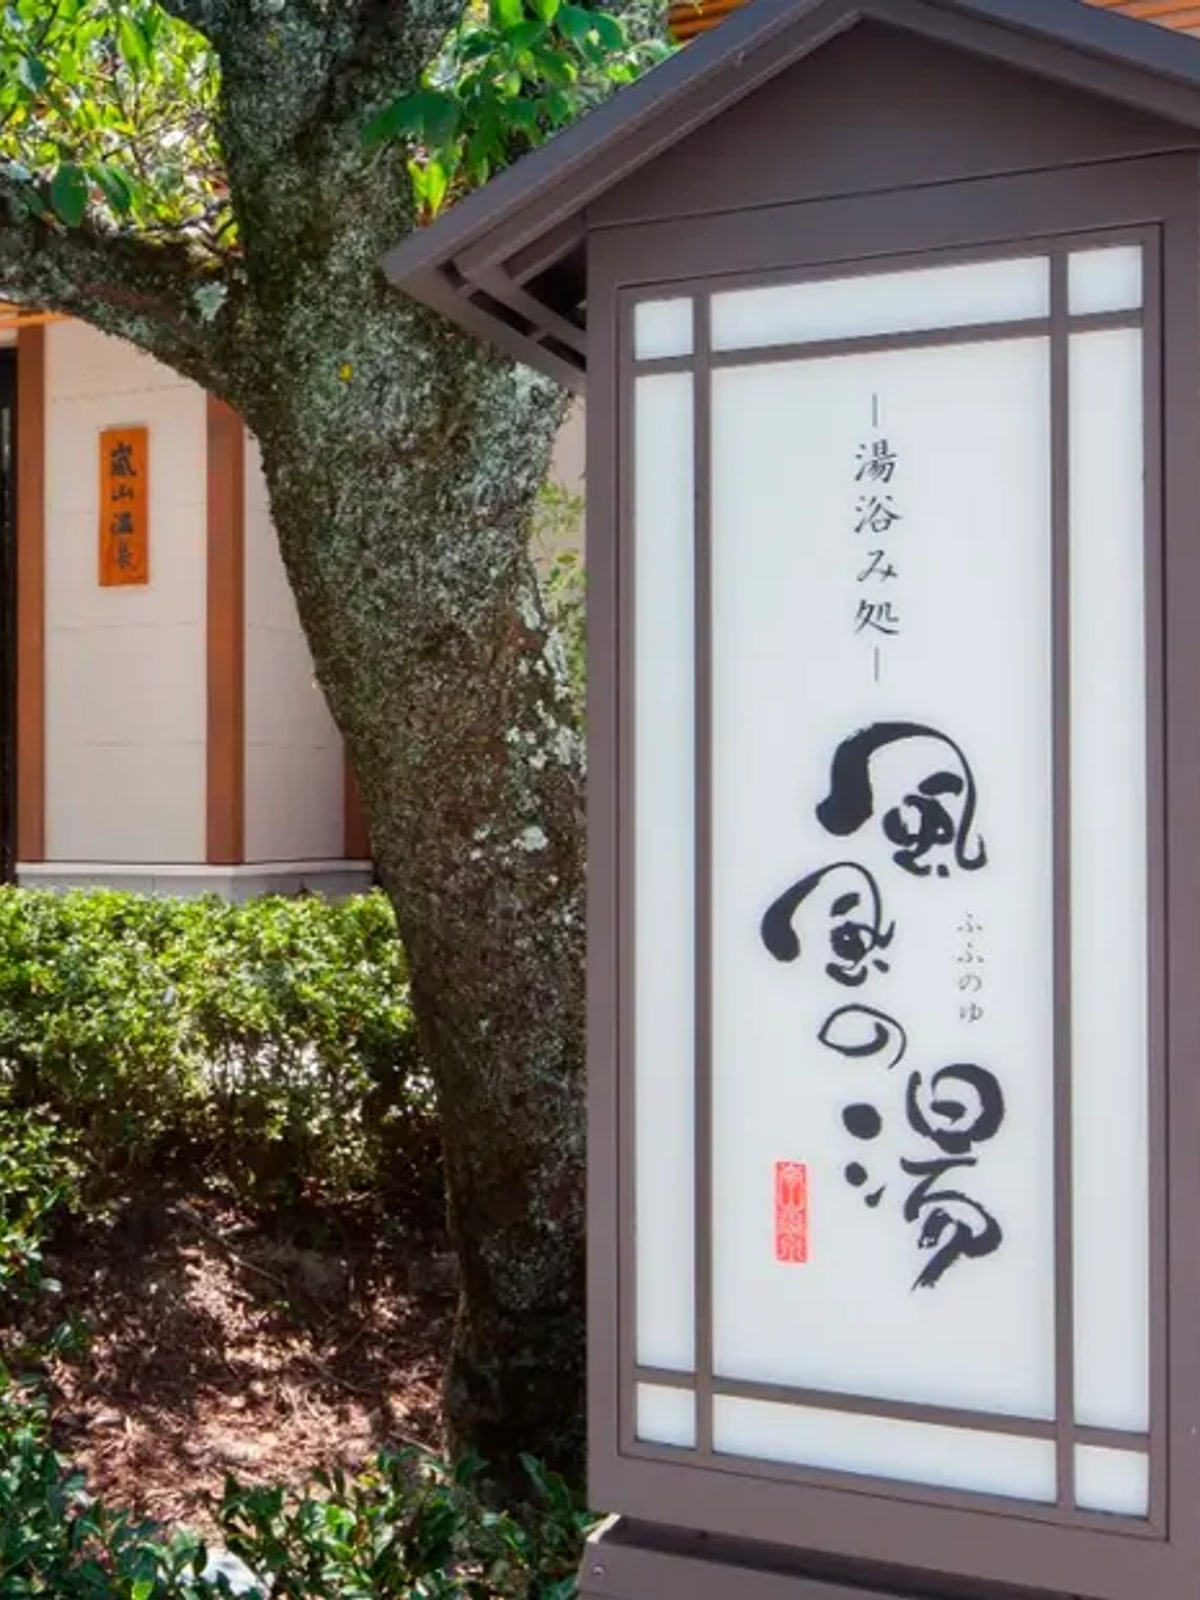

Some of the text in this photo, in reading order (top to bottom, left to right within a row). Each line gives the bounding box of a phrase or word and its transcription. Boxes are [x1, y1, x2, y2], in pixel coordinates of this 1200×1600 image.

[854, 439, 902, 635] 湯浴み処
[761, 721, 1005, 1291] 風風の湯
[957, 912, 985, 1023] ふふのゆ
